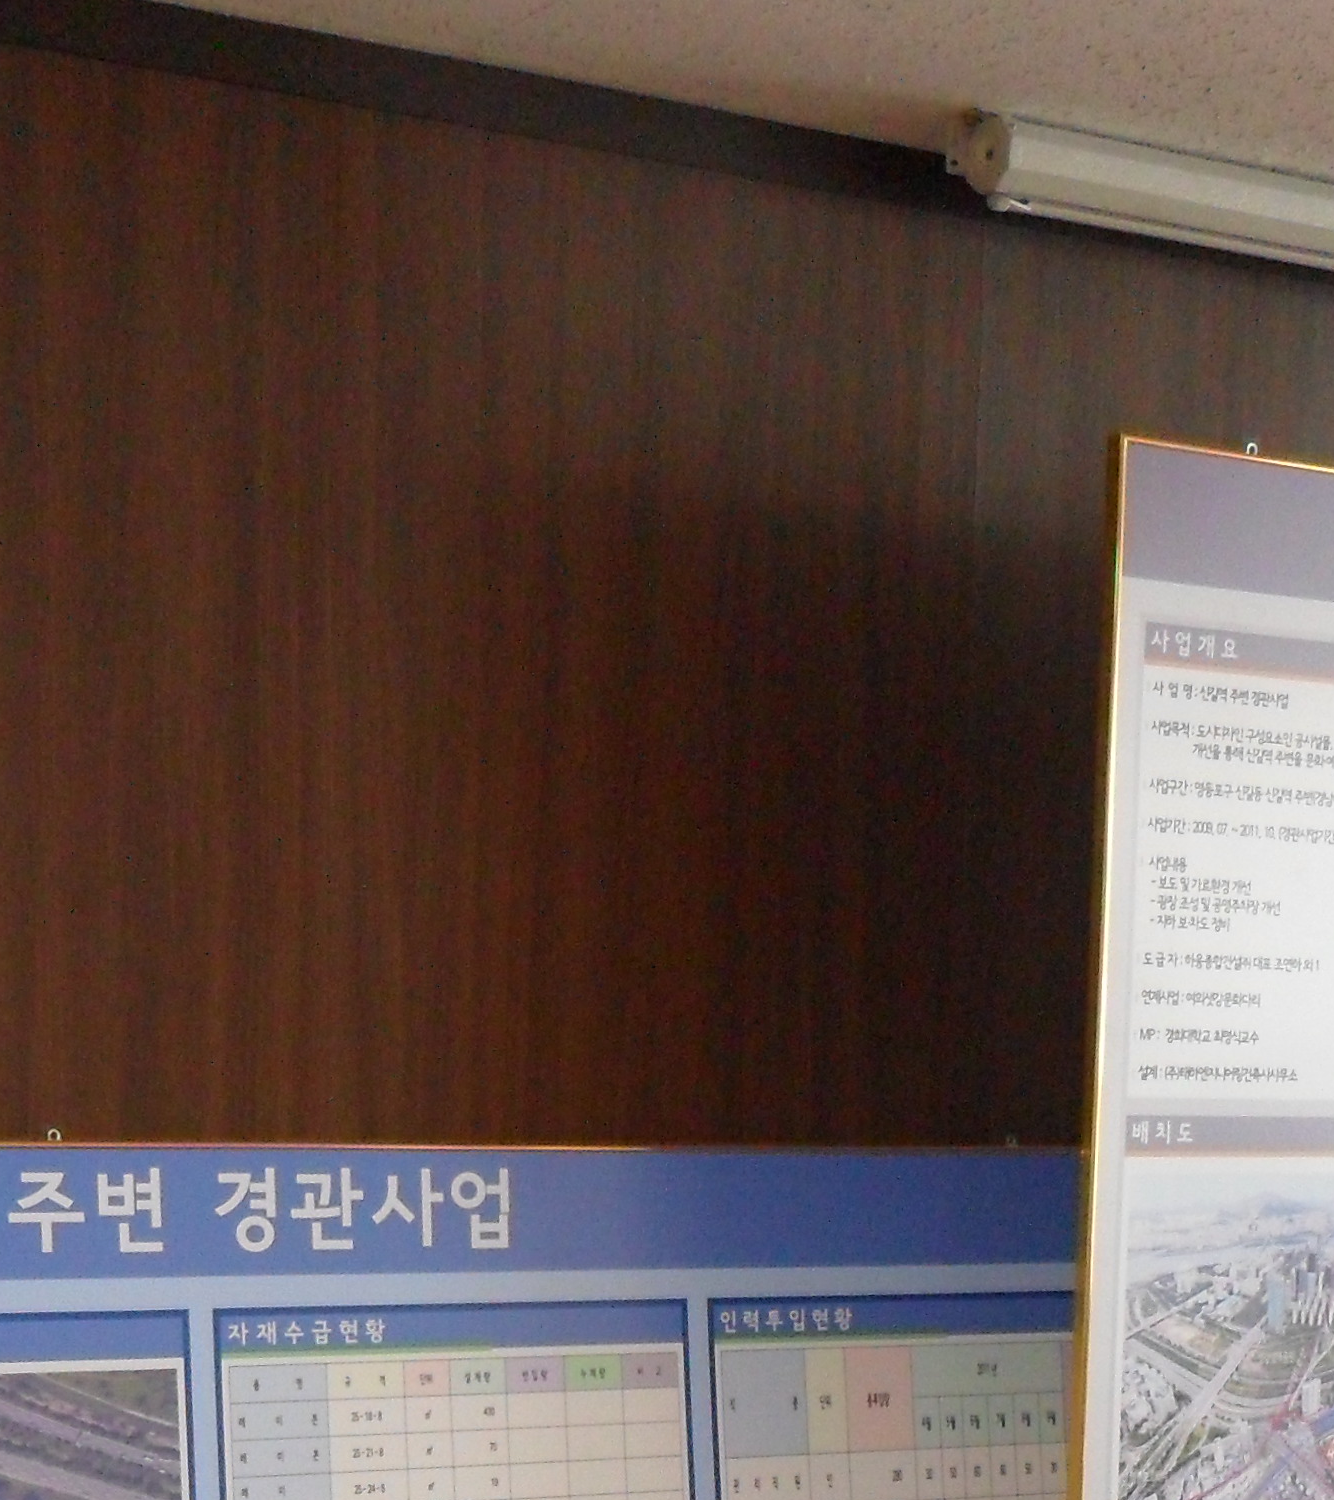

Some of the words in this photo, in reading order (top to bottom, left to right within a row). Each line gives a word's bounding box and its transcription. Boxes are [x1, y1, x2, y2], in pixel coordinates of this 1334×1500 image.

[7, 1167, 164, 1253] 주변
[214, 1166, 510, 1253] 경관사업
[228, 1318, 386, 1346] 자재수급현황
[719, 1307, 853, 1334] 인력투입현황
